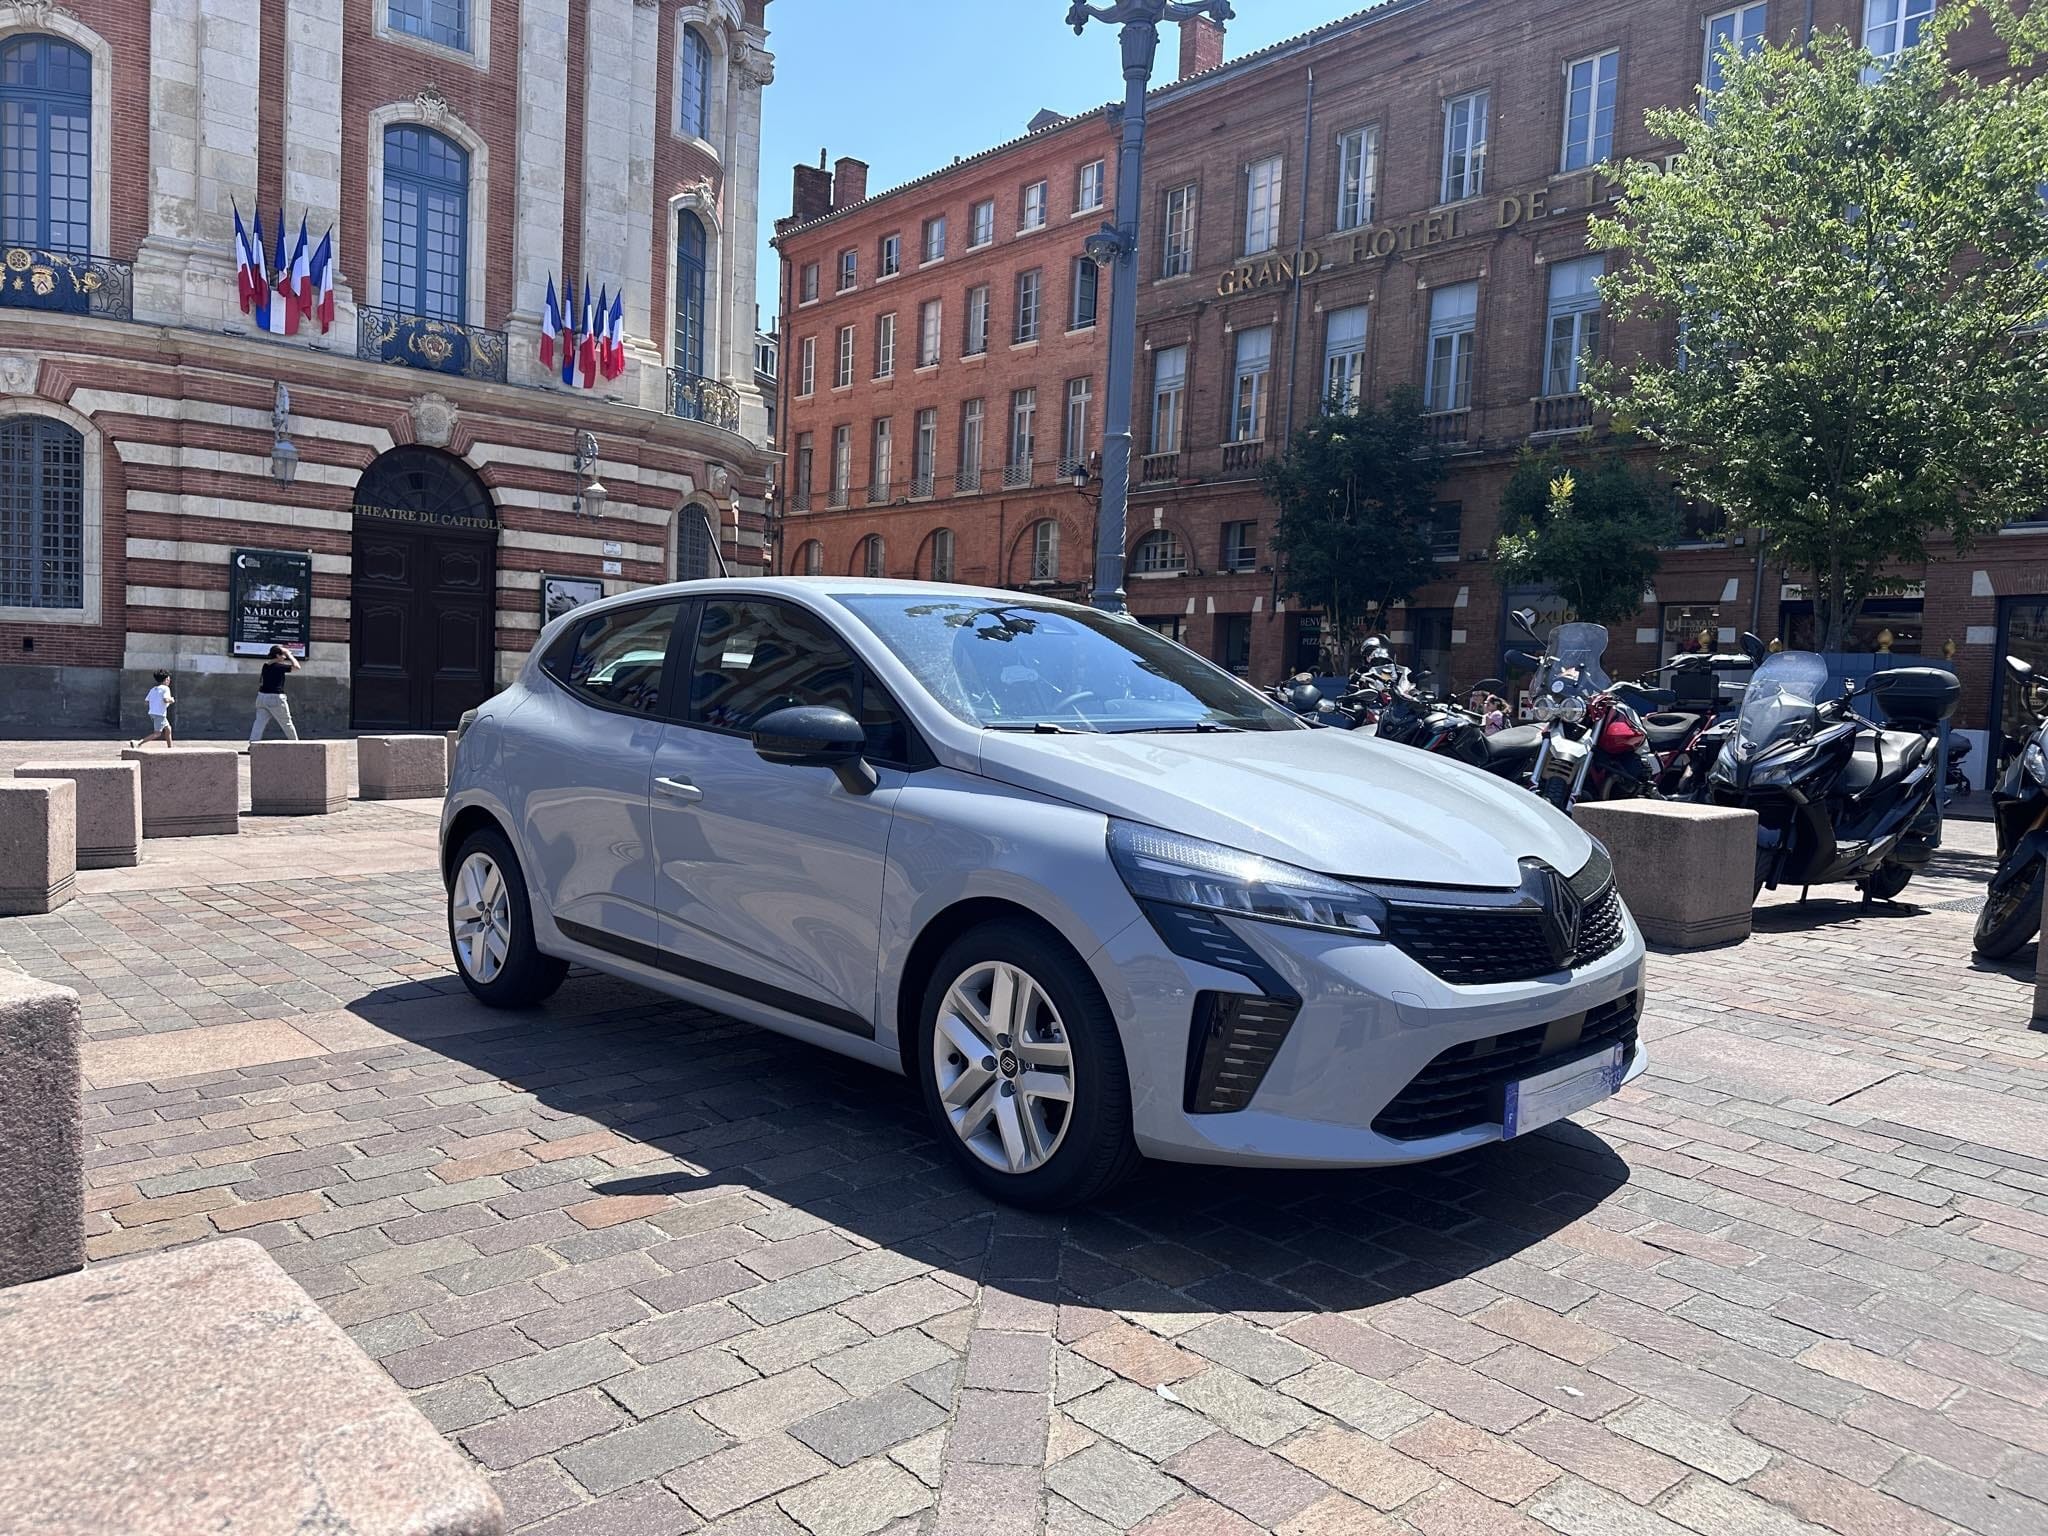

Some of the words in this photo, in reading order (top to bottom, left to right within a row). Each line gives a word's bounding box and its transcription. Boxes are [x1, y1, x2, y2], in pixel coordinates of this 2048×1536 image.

[1217, 248, 1321, 296] GRAND
[1350, 209, 1468, 264] HOTEL
[1497, 187, 1549, 229] DE
[352, 504, 416, 521] THEATRE
[420, 512, 438, 524] DU
[441, 515, 505, 530] CAPITOLE
[244, 606, 299, 618] NABUCCO
